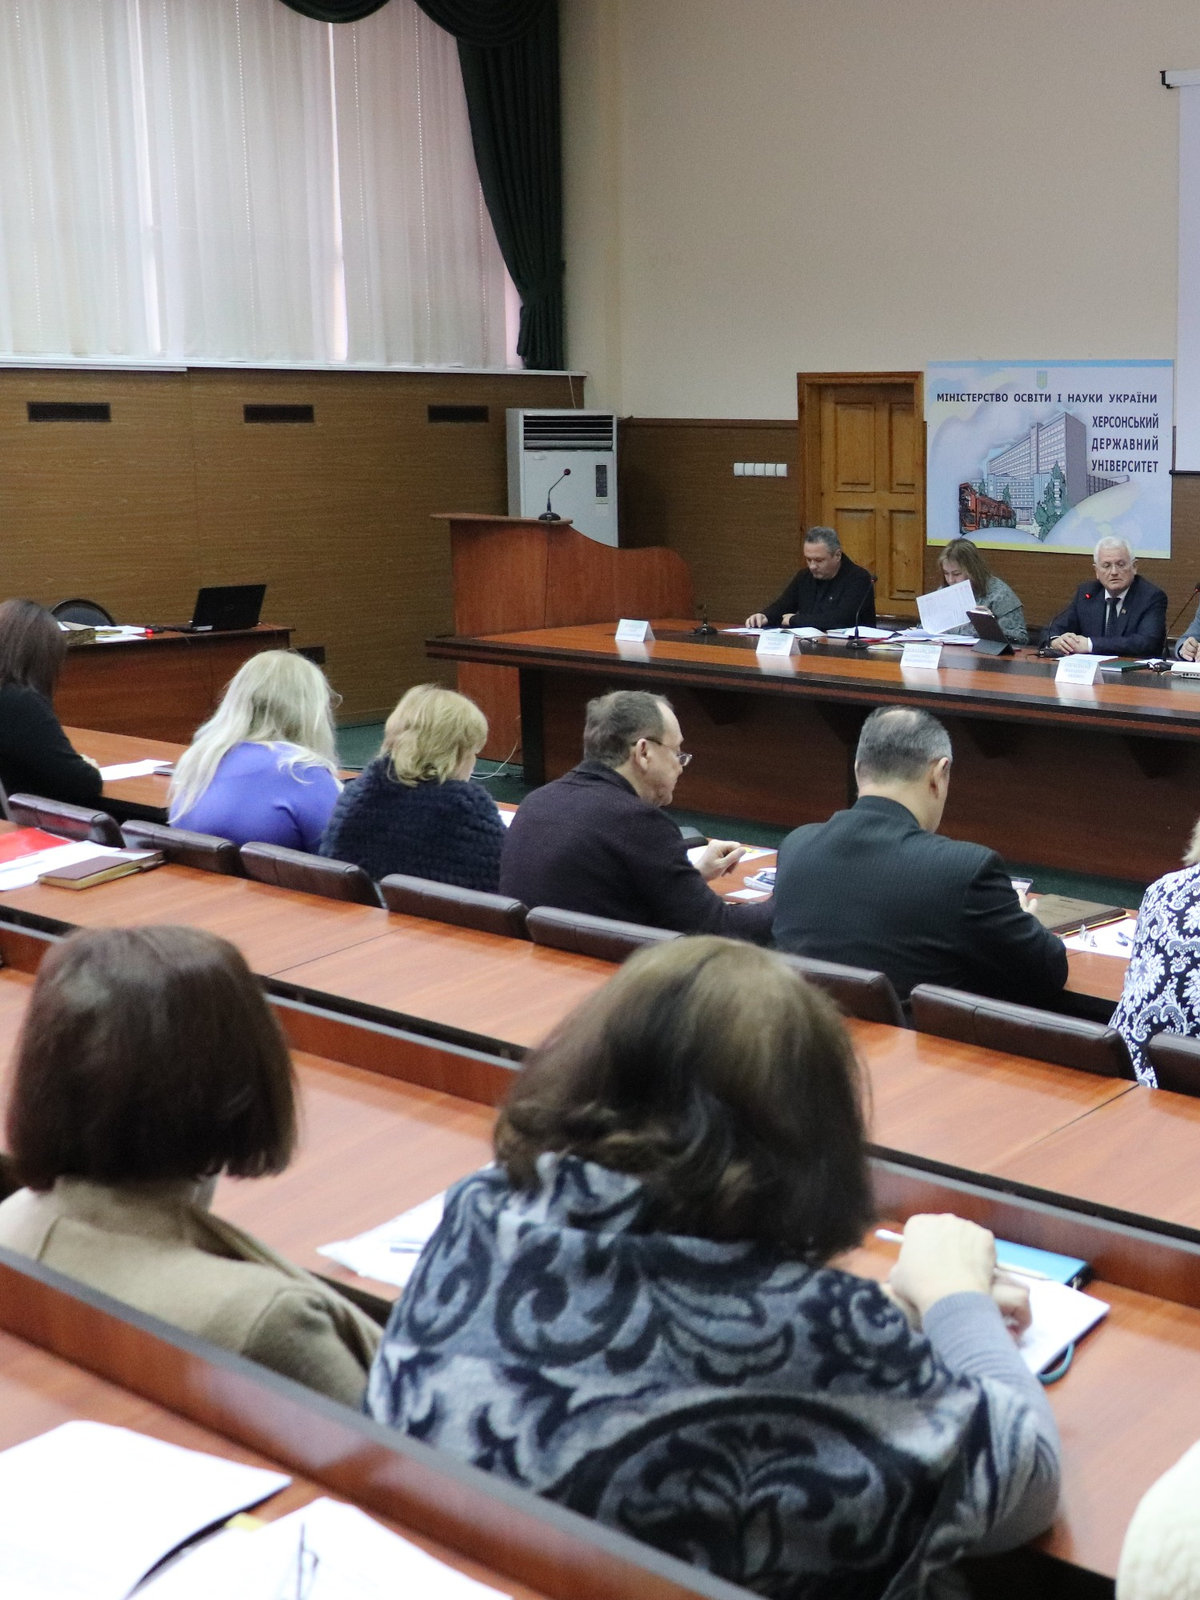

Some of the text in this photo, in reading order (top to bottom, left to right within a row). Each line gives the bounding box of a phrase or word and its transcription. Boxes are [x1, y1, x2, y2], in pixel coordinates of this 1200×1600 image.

[936, 391, 1158, 404] МІНІСТЕРСТВО ОСВІТИ І НАУКИ УКРАЇНИ
[1092, 413, 1159, 429] ХЕРСОНСЬКИЙ
[1091, 436, 1159, 452] ДЕРЖАВНИЙ
[1091, 460, 1159, 473] УНІВЕРСИТЕТ
